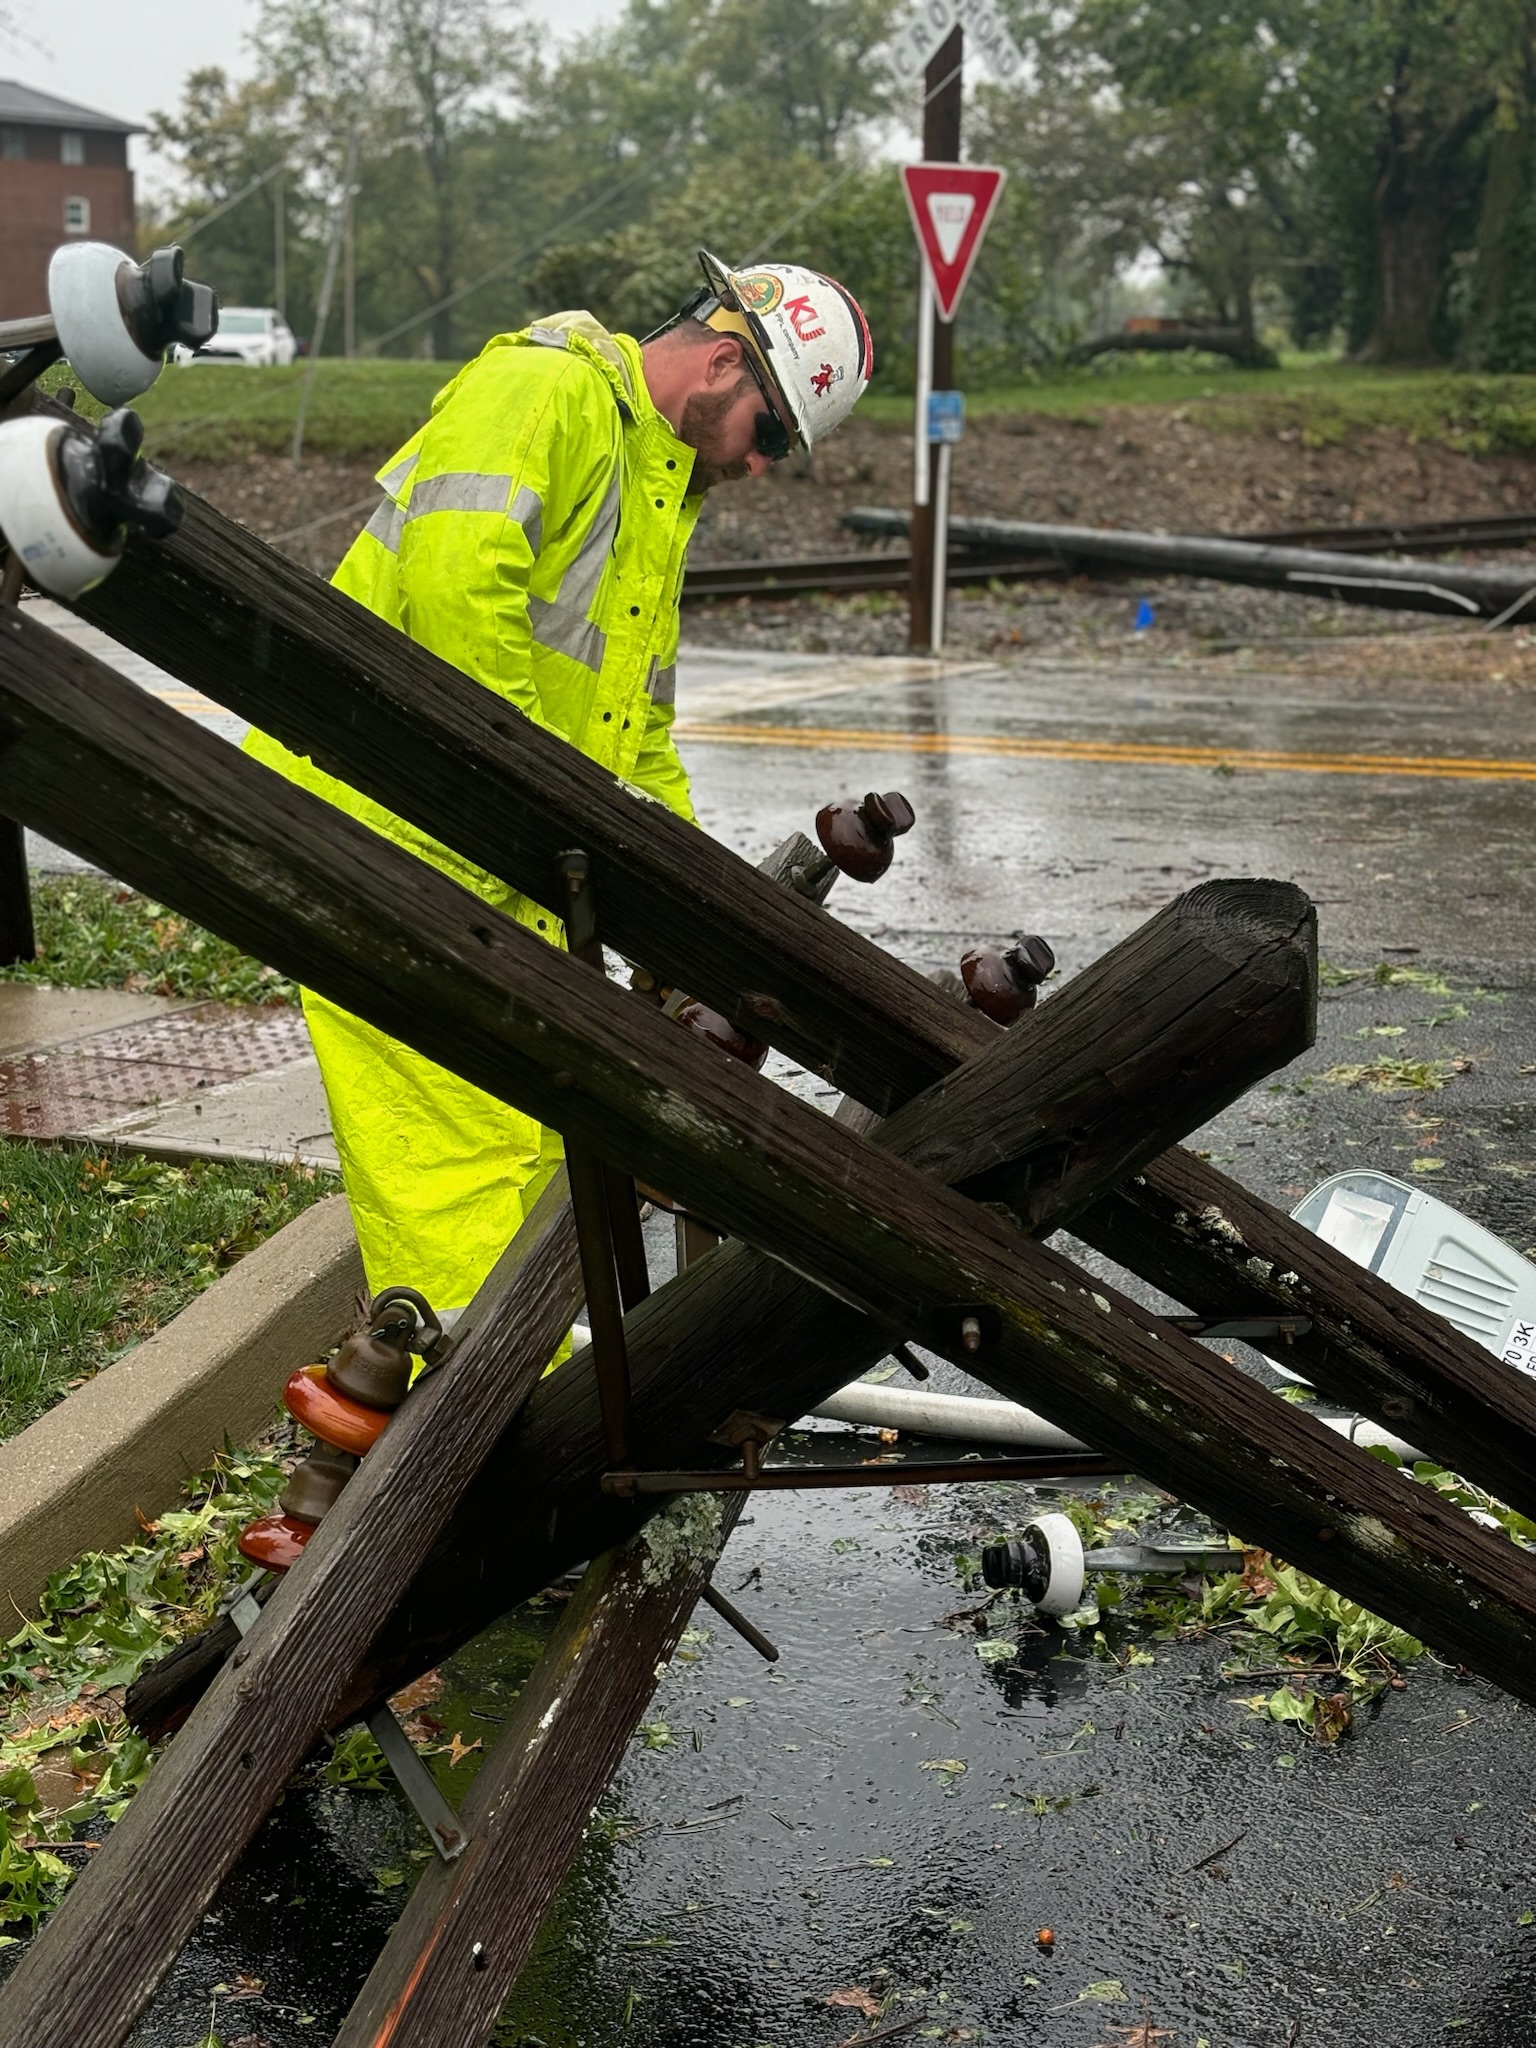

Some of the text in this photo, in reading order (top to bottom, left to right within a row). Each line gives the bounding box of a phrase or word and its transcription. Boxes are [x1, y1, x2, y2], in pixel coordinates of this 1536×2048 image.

[783, 295, 826, 341] KU
[783, 329, 801, 360] company
[1513, 1323, 1534, 1346] 3K
